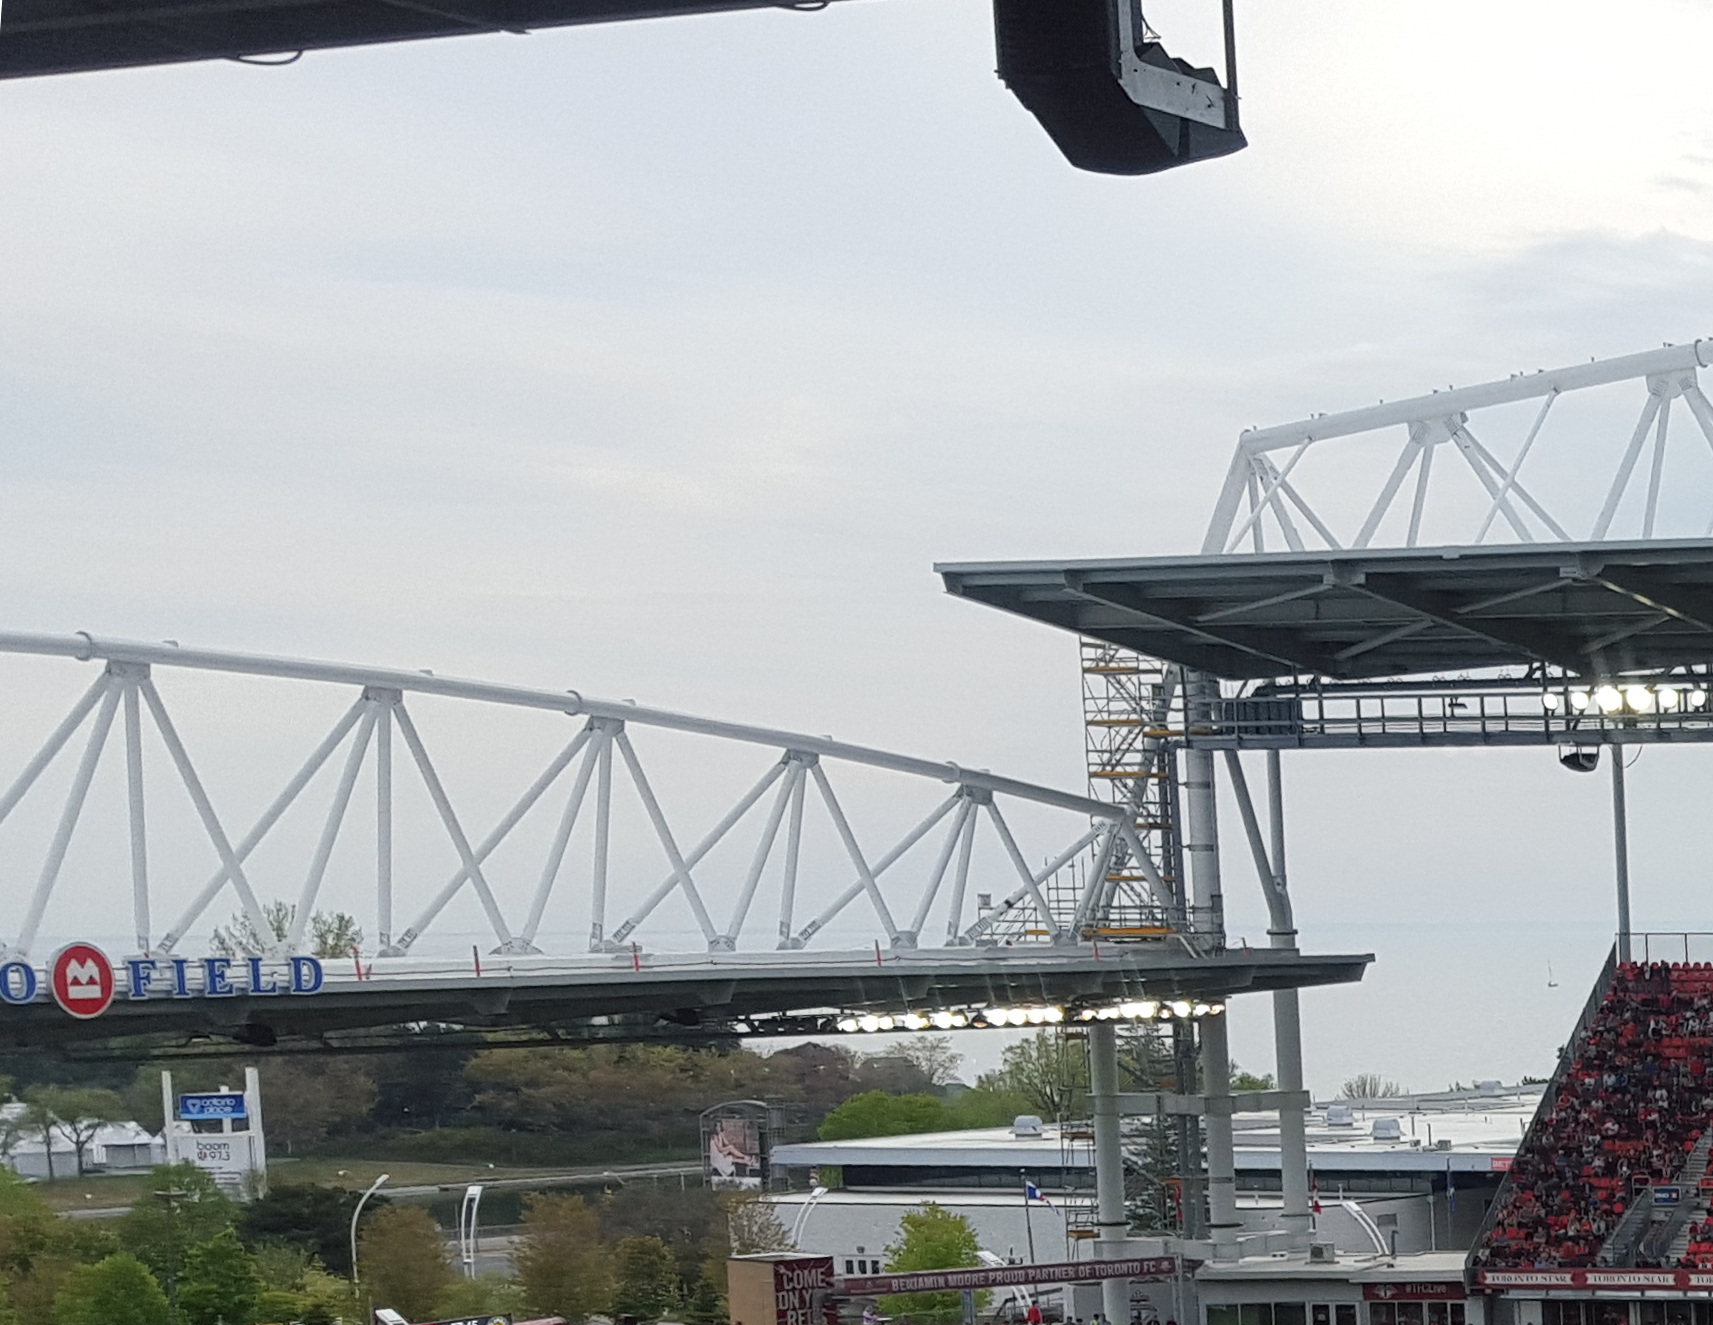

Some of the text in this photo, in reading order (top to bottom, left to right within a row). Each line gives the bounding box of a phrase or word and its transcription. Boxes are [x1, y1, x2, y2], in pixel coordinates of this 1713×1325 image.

[126, 955, 325, 999] FIELD
[196, 1141, 230, 1151] boom
[783, 1268, 827, 1290] COME
[891, 1277, 945, 1292] BENJAMIN
[948, 1274, 986, 1288] MOORE
[988, 1271, 1026, 1285] PROUD
[1028, 1266, 1076, 1282] PARTNER
[1078, 1264, 1092, 1278] OF
[1094, 1261, 1141, 1277] TORONTO
[1143, 1259, 1156, 1274] FC
[1489, 1273, 1541, 1286] TORONTO
[1591, 1273, 1643, 1286] TORONTO
[777, 1290, 800, 1310] ON
